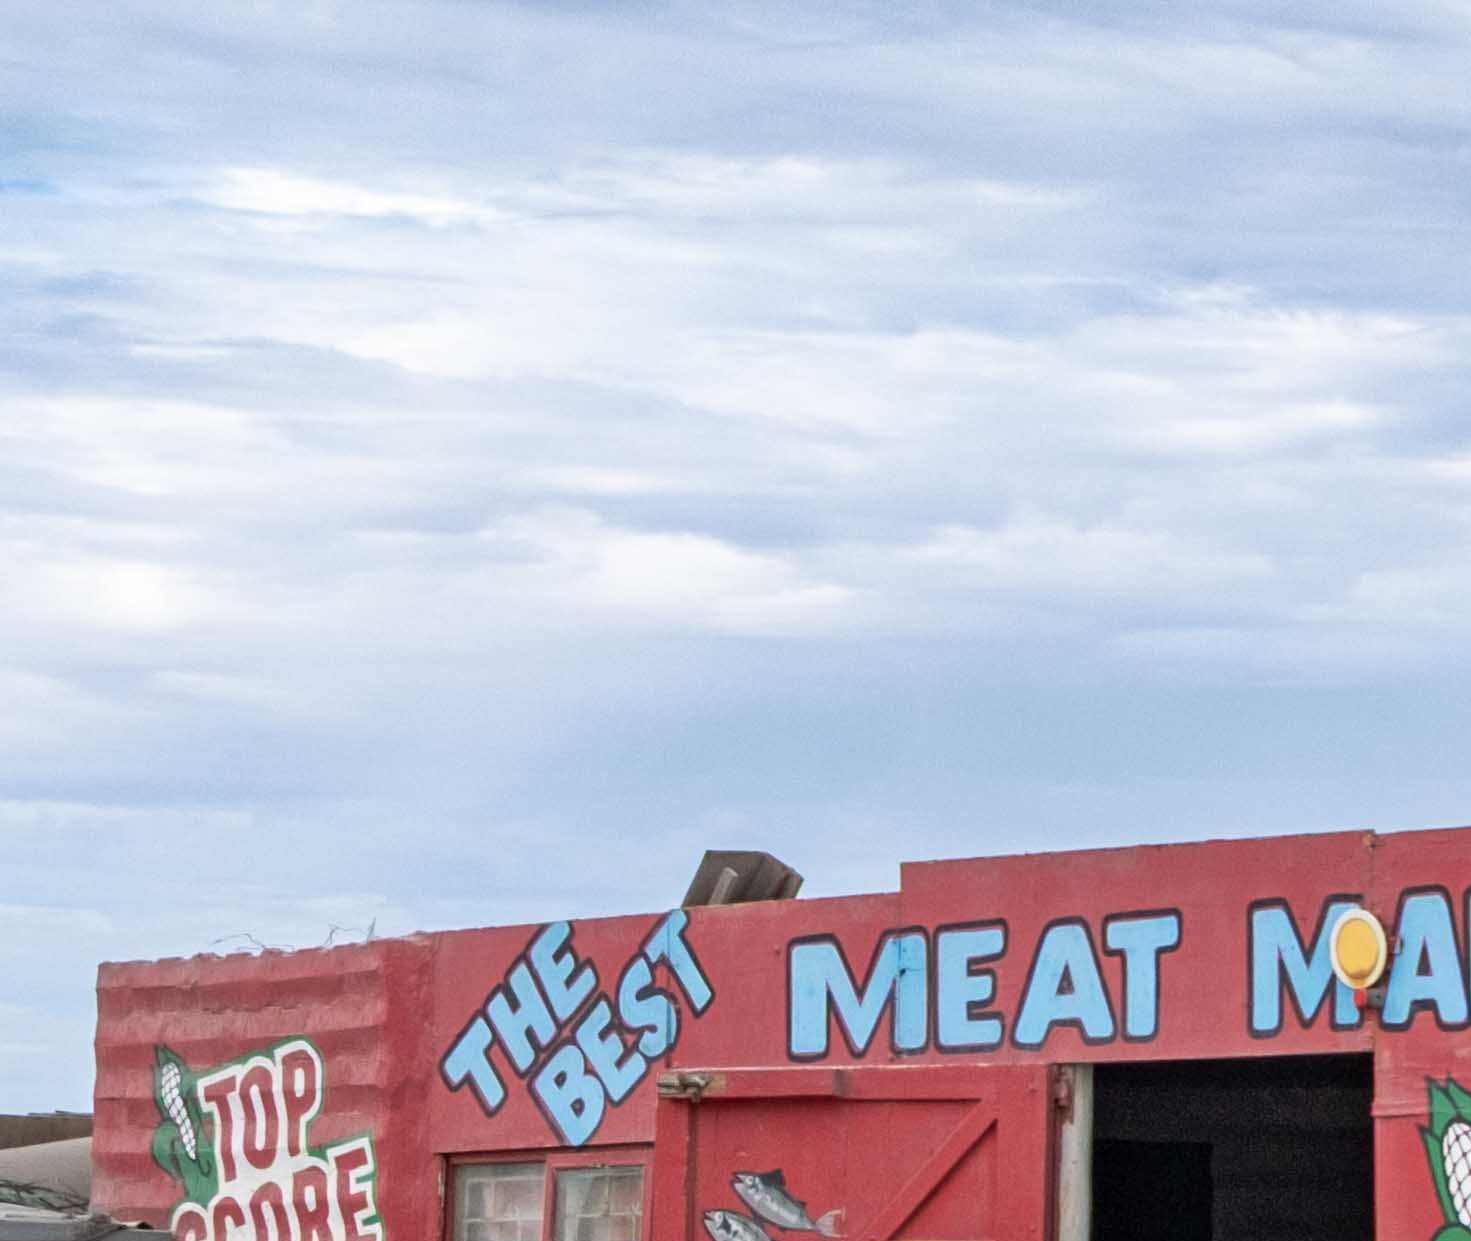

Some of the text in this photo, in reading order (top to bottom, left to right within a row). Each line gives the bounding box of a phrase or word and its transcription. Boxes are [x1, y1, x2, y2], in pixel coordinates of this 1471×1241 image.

[442, 920, 599, 1117] THE
[530, 908, 717, 1147] BEST
[787, 908, 1182, 1060] MEAT
[202, 1046, 317, 1184] TOP
